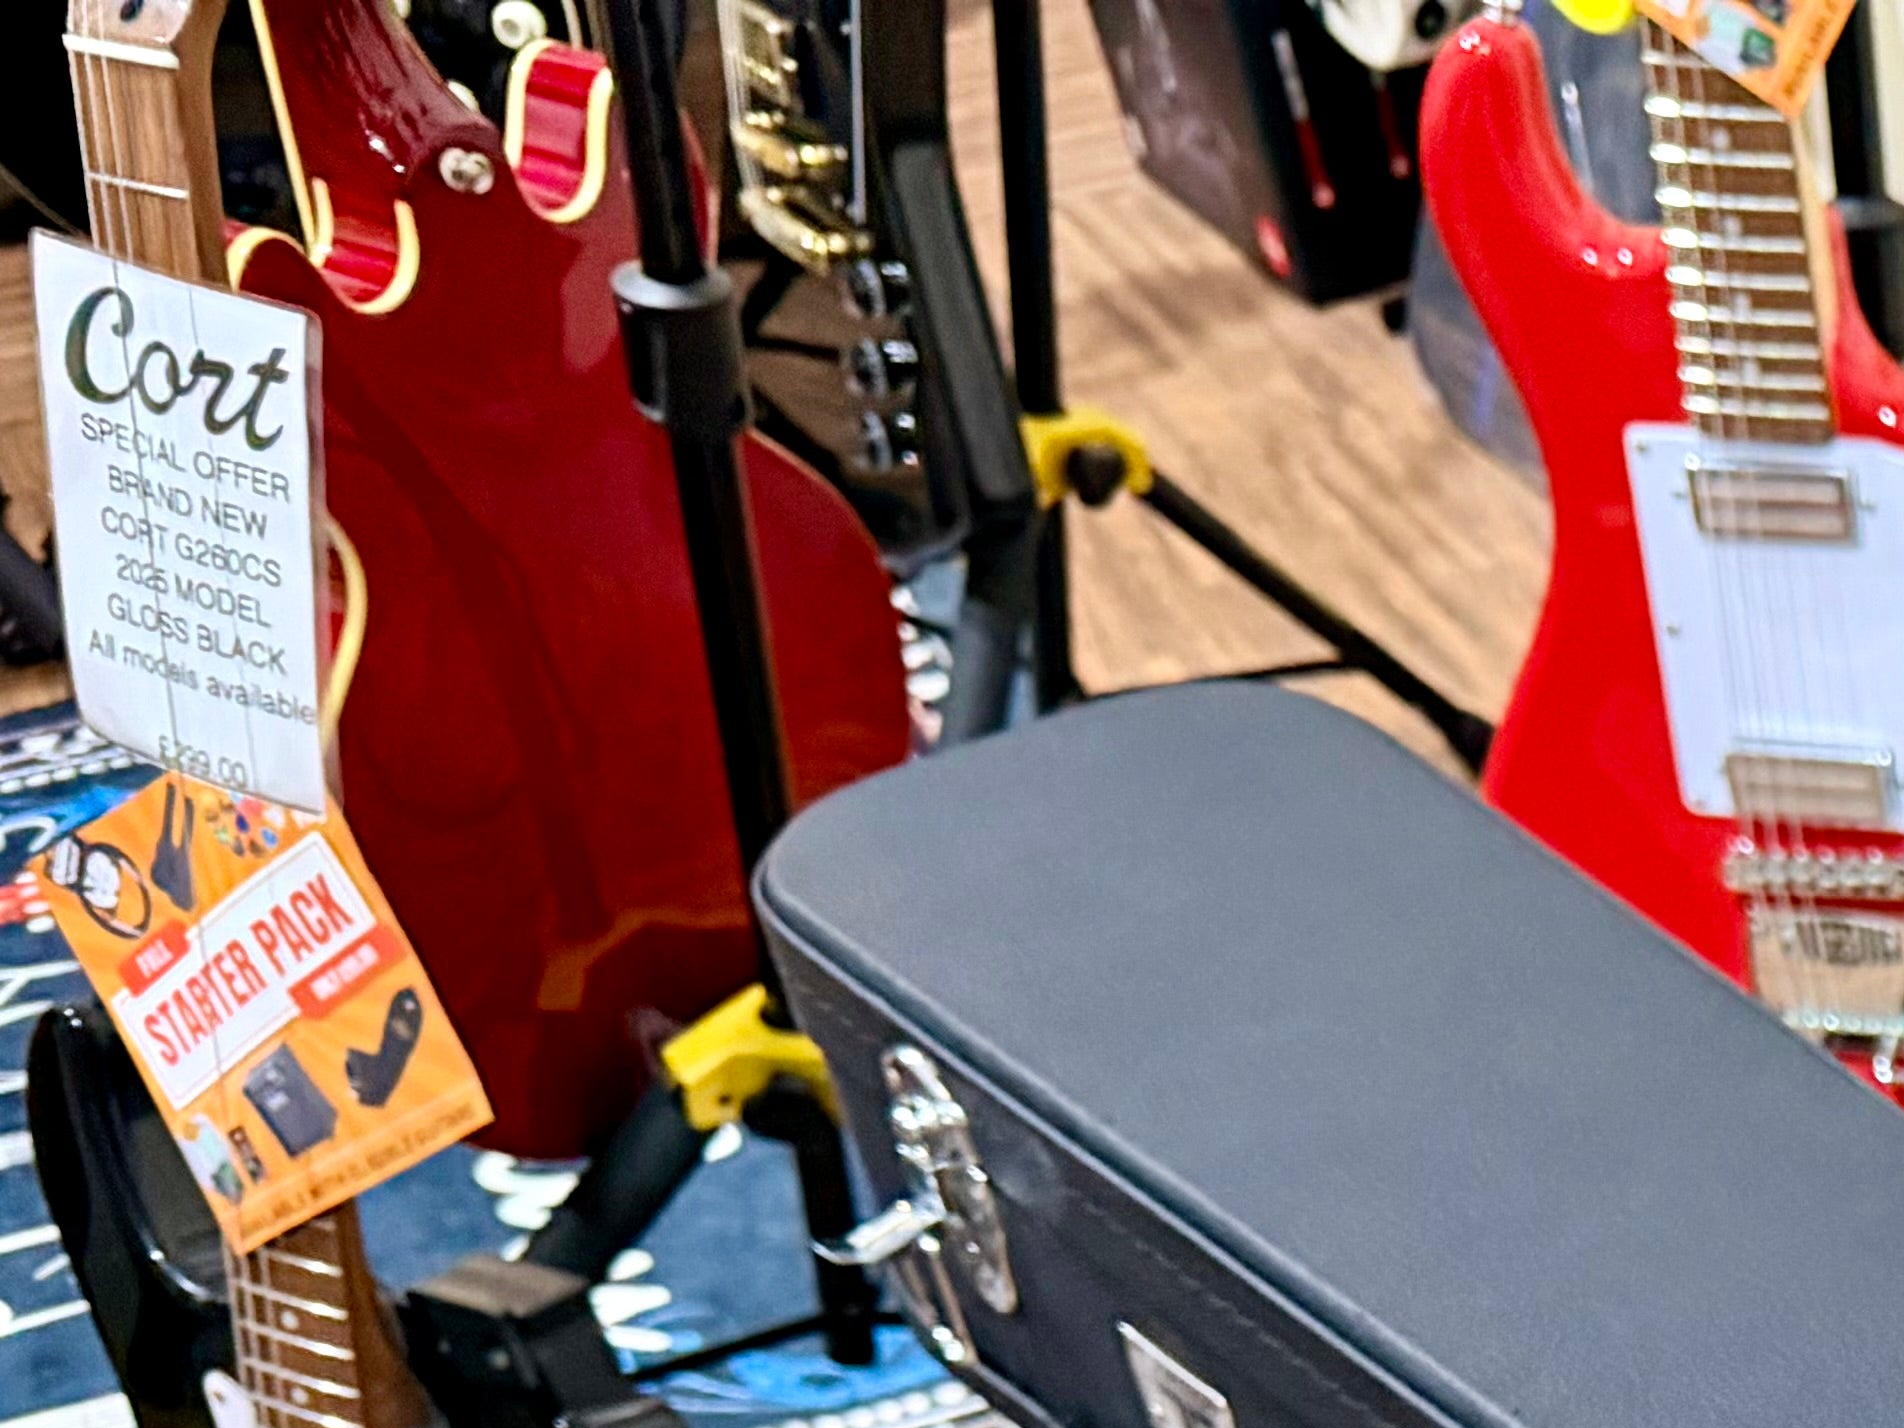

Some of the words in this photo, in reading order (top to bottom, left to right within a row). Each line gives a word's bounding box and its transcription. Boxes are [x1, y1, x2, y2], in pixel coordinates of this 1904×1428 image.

[65, 286, 289, 451] Cort
[80, 412, 187, 473] SPECIAL
[193, 451, 290, 504] OFFER
[107, 464, 193, 517] BRAND
[201, 495, 268, 539] NEW
[101, 506, 168, 554] CORT
[107, 593, 189, 644] GLOSS
[197, 624, 287, 677] BLACK
[175, 573, 272, 629] MODEL
[89, 629, 116, 661] All
[123, 646, 199, 690] models
[206, 676, 316, 726] available
[144, 939, 268, 1066] STARTER
[250, 872, 355, 978] PACK
